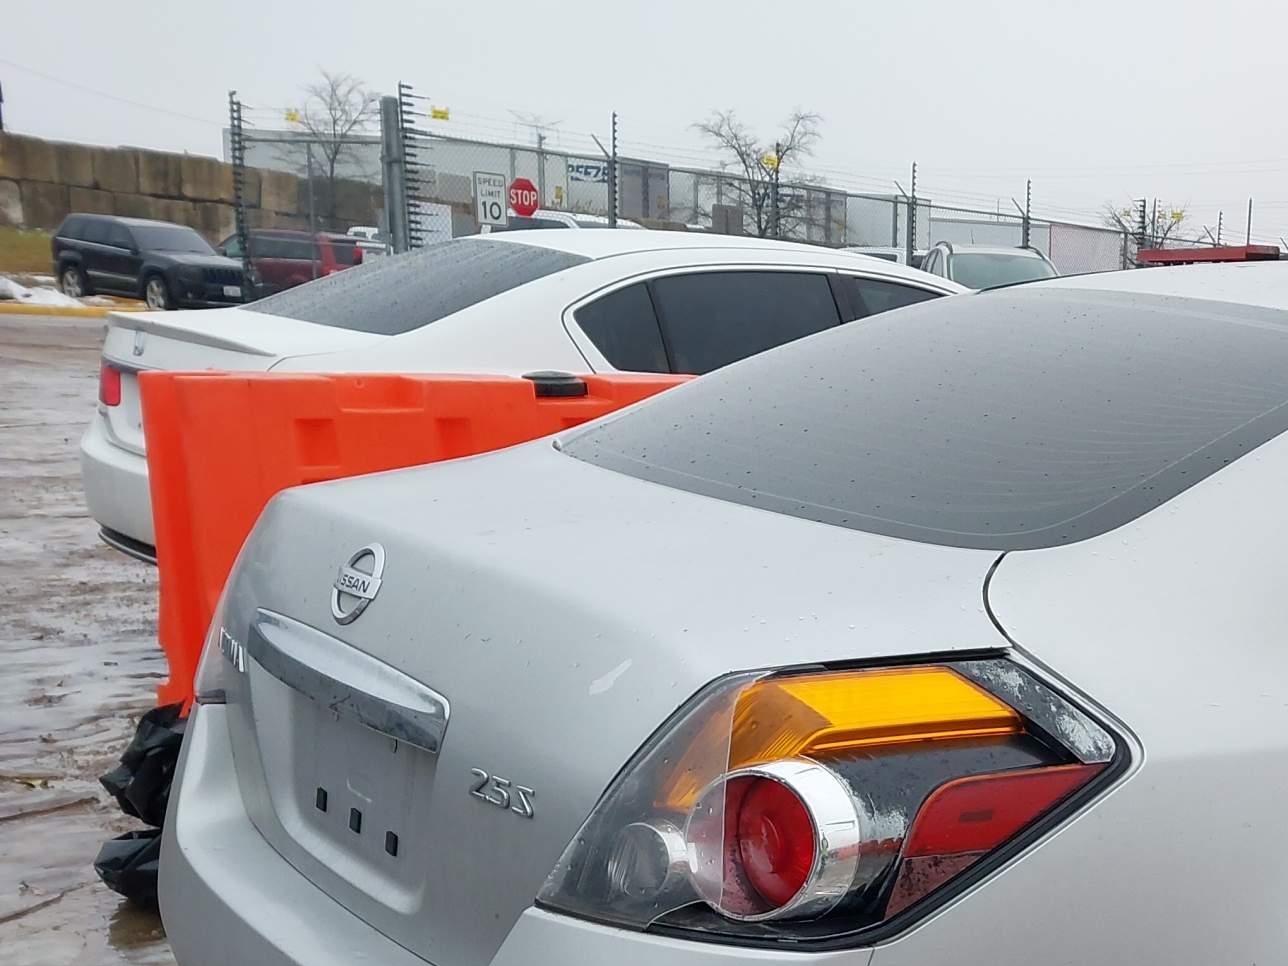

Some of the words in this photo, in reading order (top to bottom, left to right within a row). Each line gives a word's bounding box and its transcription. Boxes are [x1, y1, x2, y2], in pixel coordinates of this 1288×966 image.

[477, 177, 503, 187] SPEED
[480, 189, 501, 199] LIMIT
[510, 188, 537, 206] STOP
[481, 201, 502, 220] 10
[336, 573, 371, 594] SSAN
